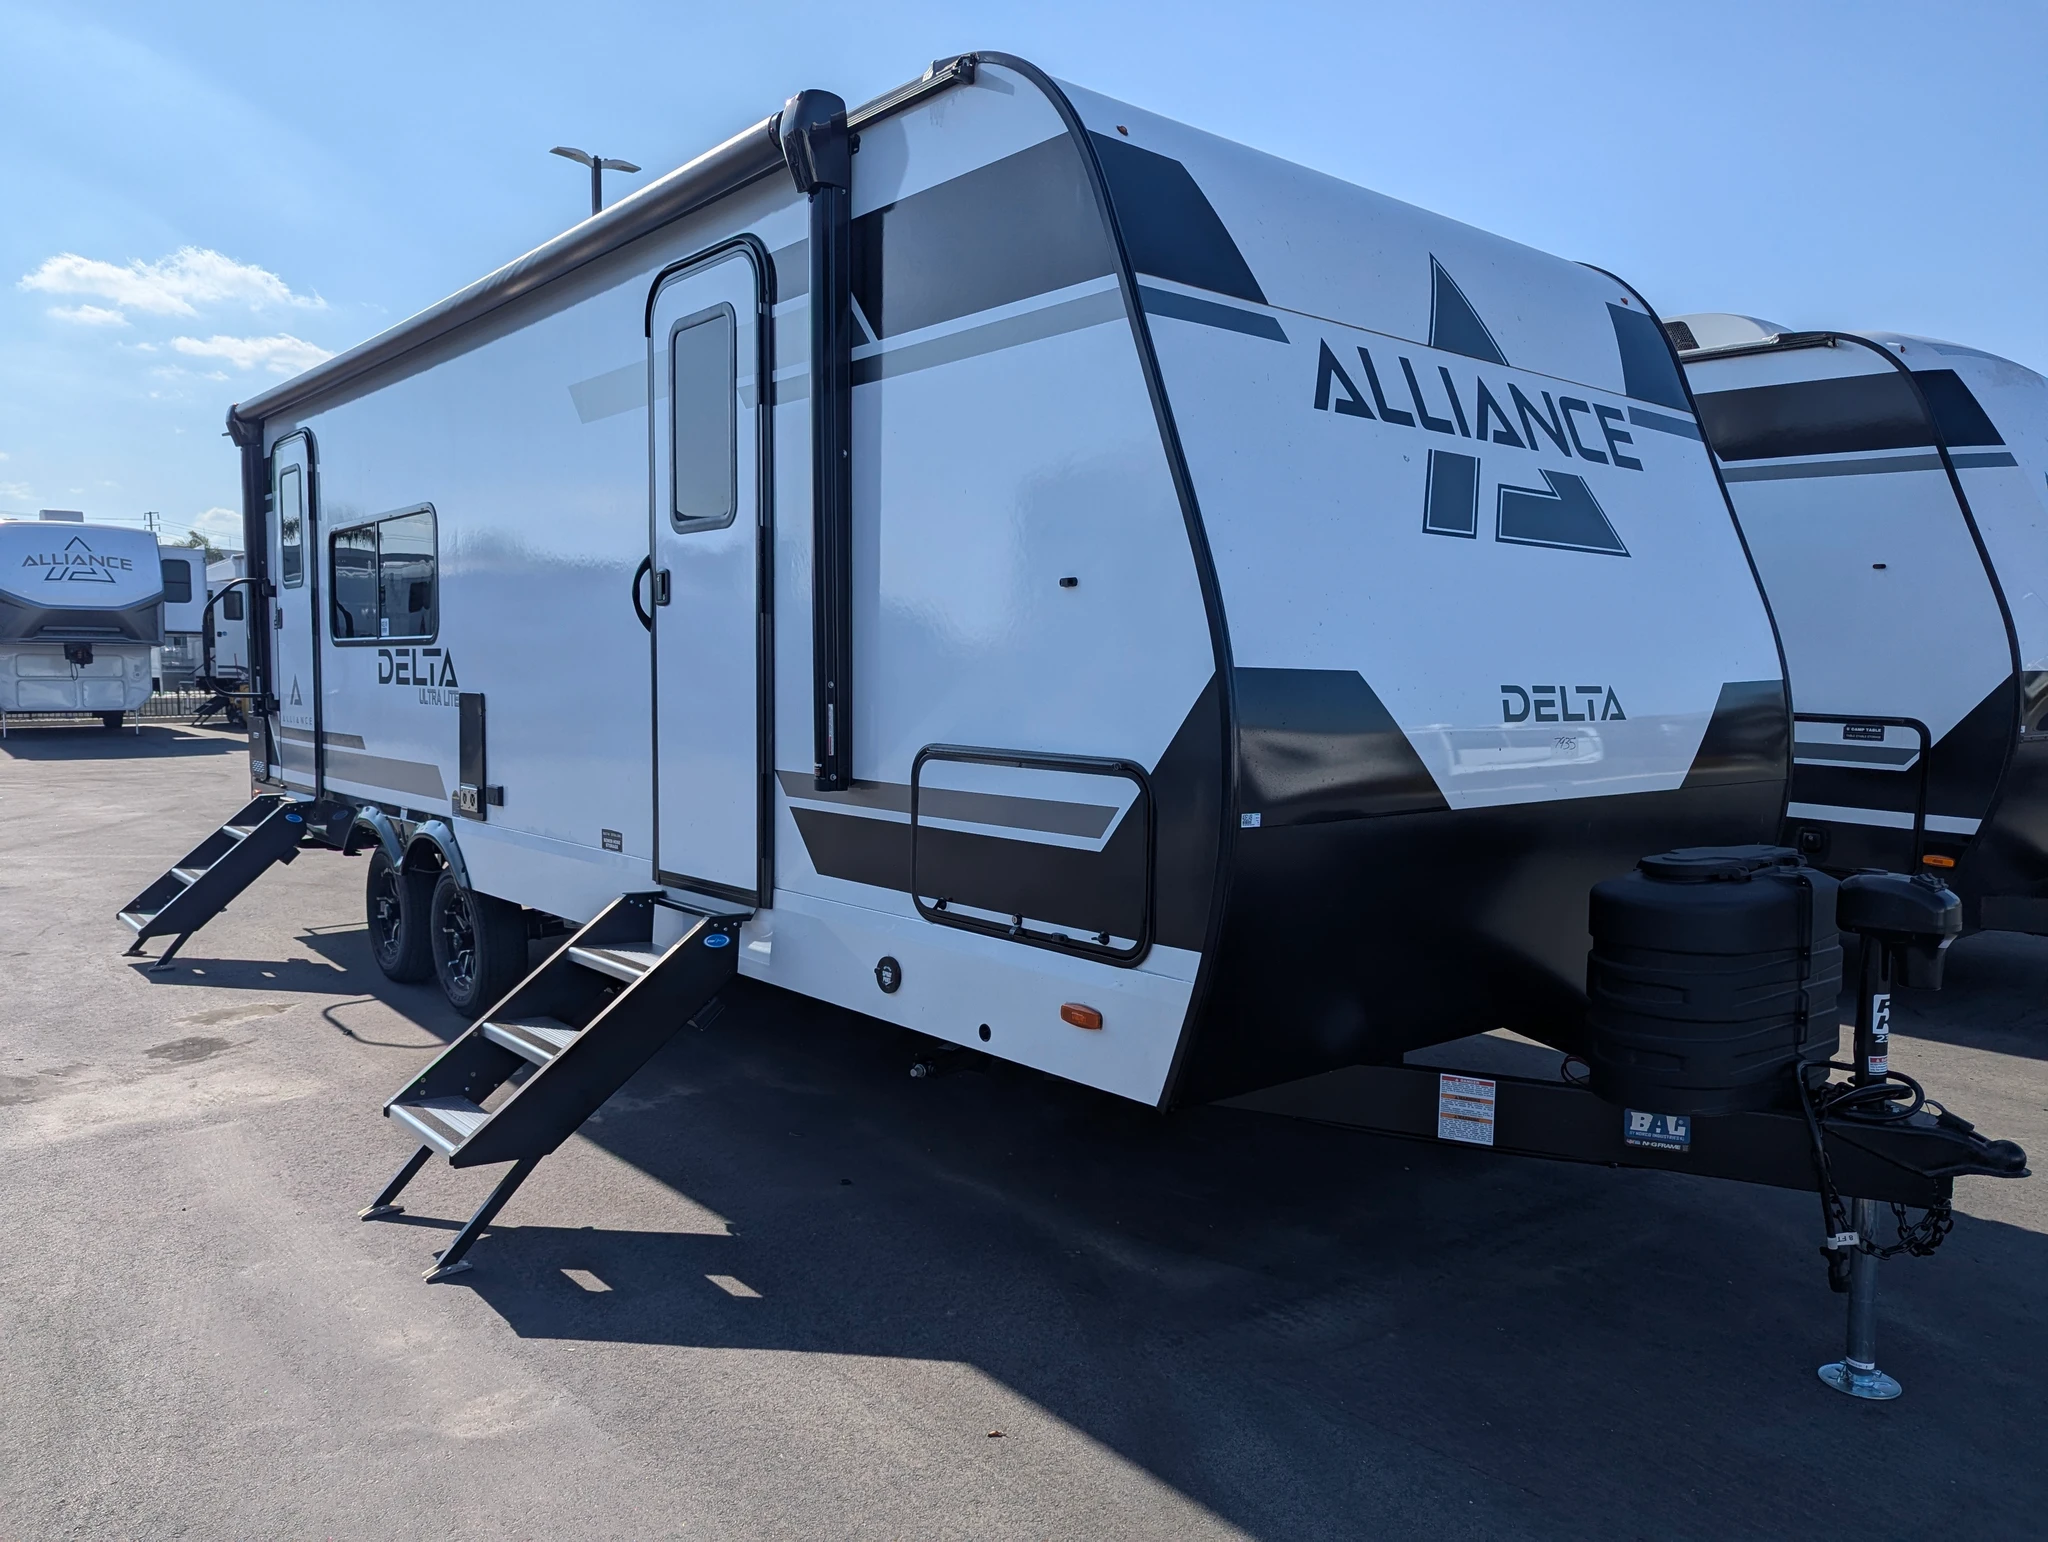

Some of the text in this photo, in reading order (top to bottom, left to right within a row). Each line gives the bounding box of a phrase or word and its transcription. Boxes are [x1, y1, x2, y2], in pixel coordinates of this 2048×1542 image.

[1314, 337, 1644, 472] ALLIANCE
[21, 553, 133, 572] ALLIANCE
[378, 647, 459, 688] DELTA
[419, 688, 460, 708] ULTRA LITE
[1501, 685, 1627, 723] DELTA
[1629, 1111, 1687, 1137] BAL
